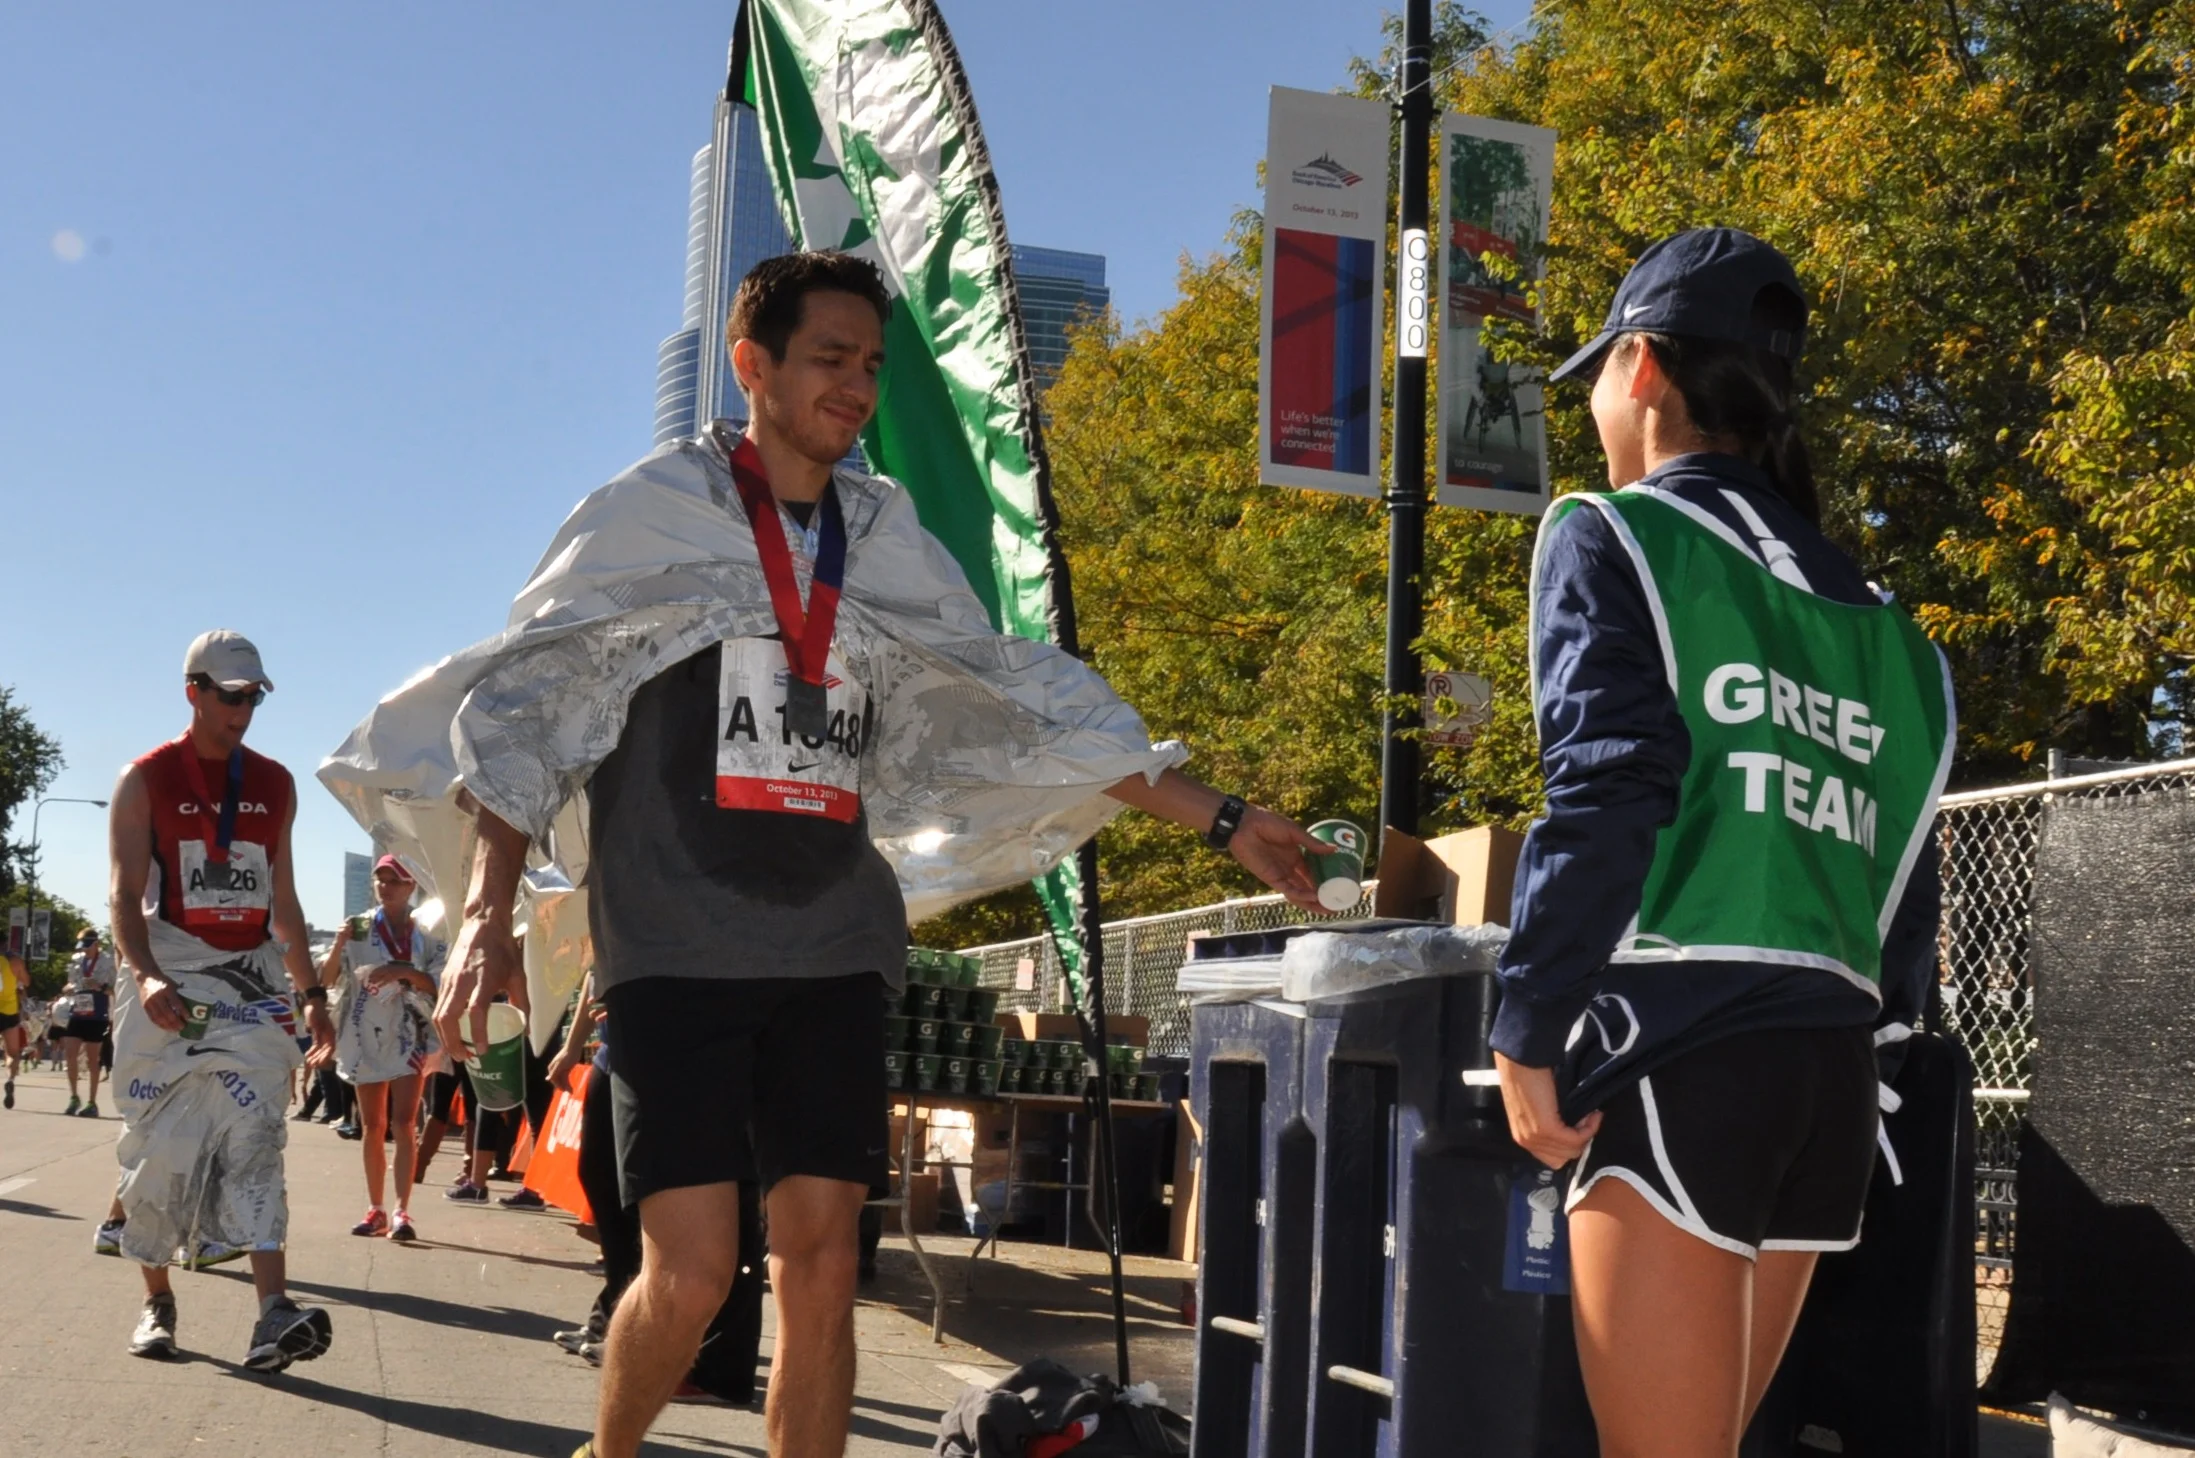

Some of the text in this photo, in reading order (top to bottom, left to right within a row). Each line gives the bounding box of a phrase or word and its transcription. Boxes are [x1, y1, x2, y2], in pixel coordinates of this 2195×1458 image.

[1281, 409, 1345, 427] Life's better
[1281, 424, 1341, 440] when we're
[1281, 439, 1336, 453] connected
[724, 695, 861, 759] A 148
[766, 783, 802, 796] October
[804, 786, 818, 798] 13,
[178, 802, 268, 814] CNDA
[1727, 751, 1878, 859] TEAM
[1333, 827, 1357, 850] G
[189, 867, 258, 891] A 26
[192, 1005, 209, 1019] G
[921, 1023, 932, 1035] G
[1133, 1050, 1143, 1060] G
[949, 1061, 961, 1074] G
[129, 1077, 166, 1100] Octo
